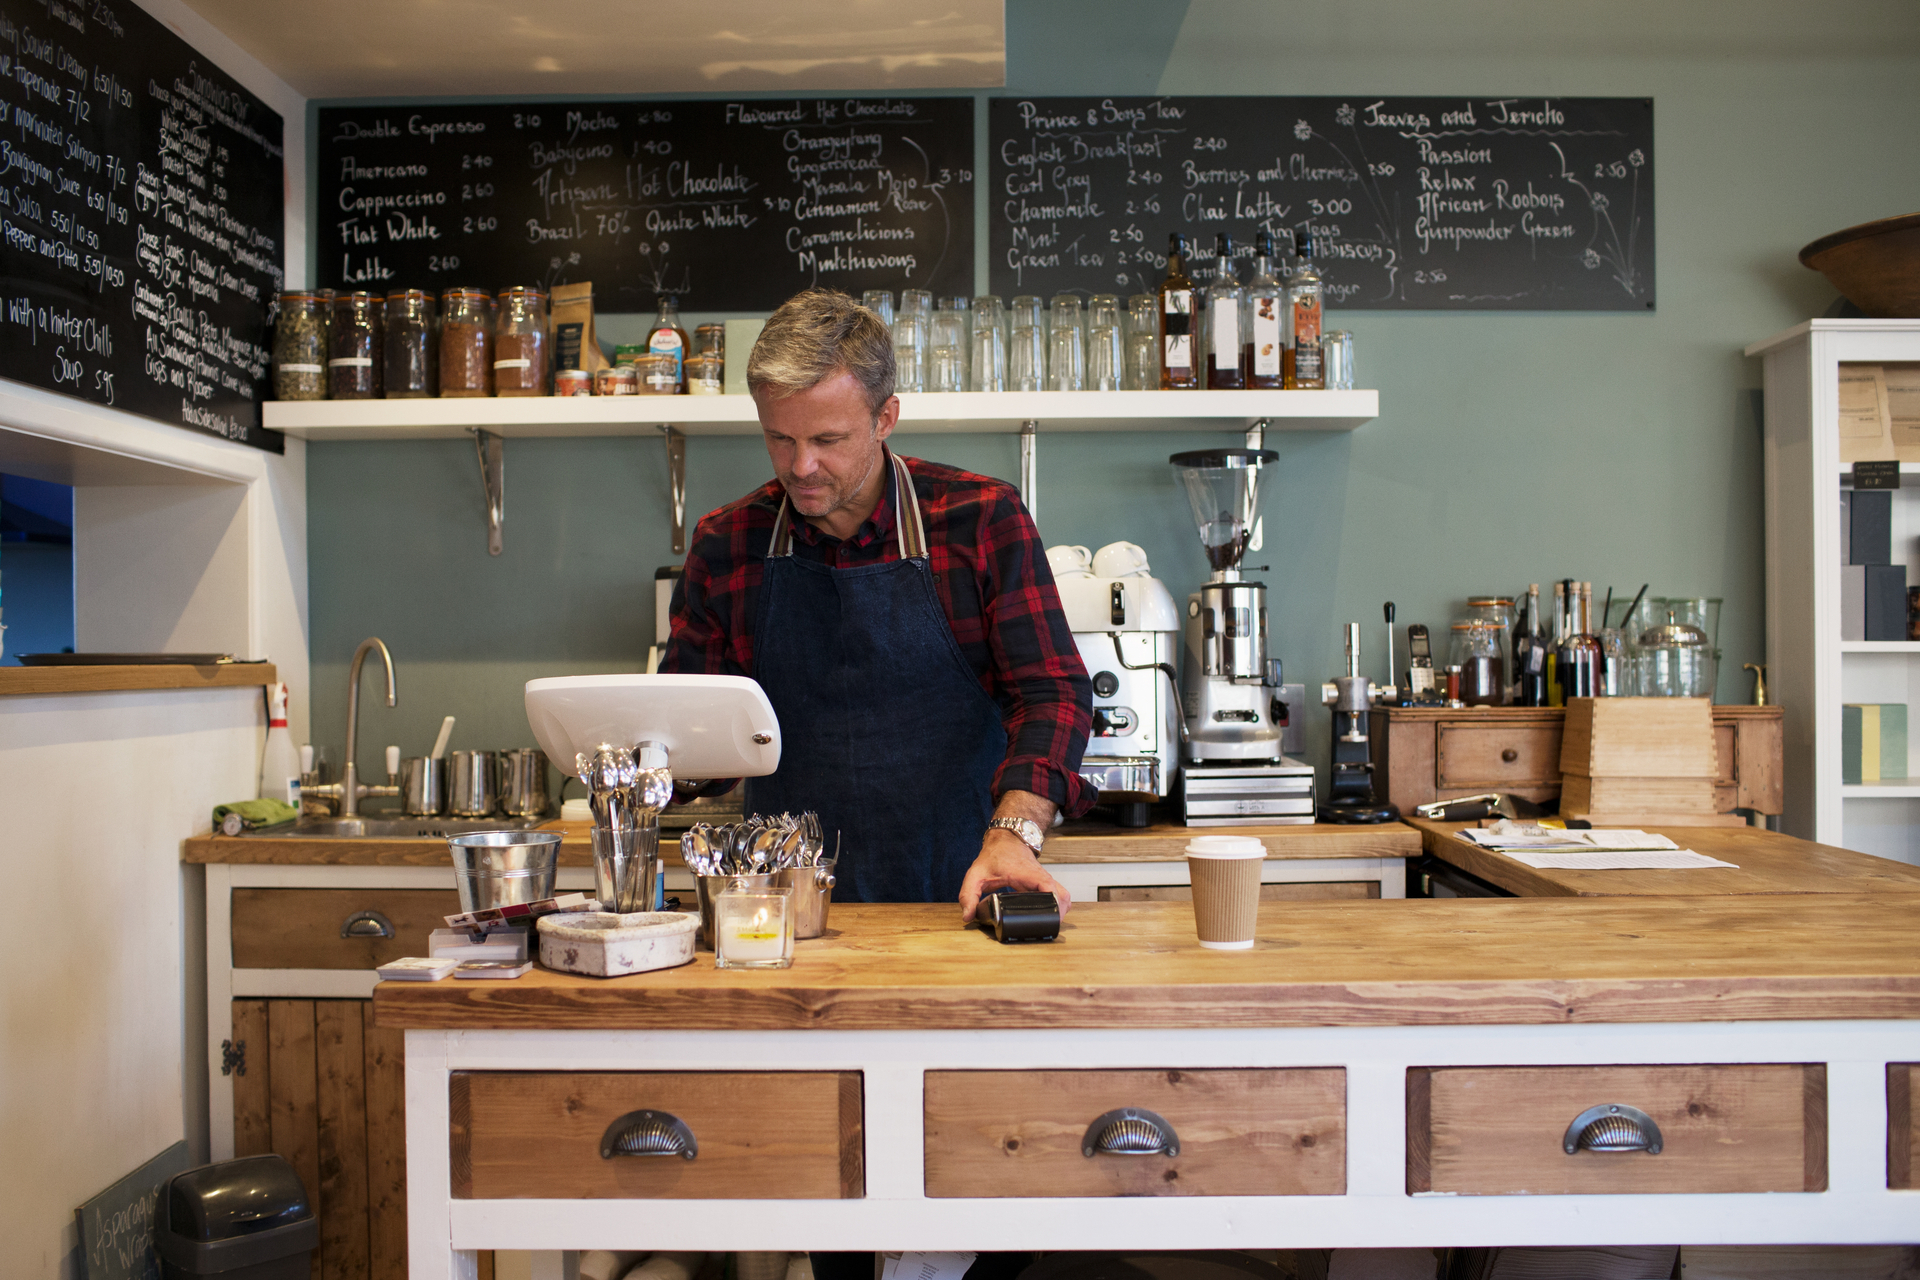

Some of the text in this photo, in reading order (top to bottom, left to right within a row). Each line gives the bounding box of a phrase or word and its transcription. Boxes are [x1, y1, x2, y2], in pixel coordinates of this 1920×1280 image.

[57, 45, 88, 90] Cream
[14, 58, 61, 106] tapenade
[66, 88, 90, 125] 7/12
[161, 107, 180, 135] White
[566, 110, 619, 145] Mocha
[726, 98, 918, 124] Flavoured Hot Chocolate
[1017, 96, 1187, 129] Prince & Sons Tea
[1363, 99, 1565, 132] Jeeves and Jericho
[159, 128, 182, 154] Brown
[333, 120, 402, 143] Double
[408, 115, 486, 144] Espresso
[63, 133, 101, 174] Salmon
[106, 154, 127, 190] 7/12
[158, 149, 186, 176] Toasted
[528, 140, 613, 176] Babycino
[787, 151, 884, 183] Gingerbread
[1001, 136, 1067, 177] English
[1068, 131, 1167, 169] Breakfast
[1416, 138, 1493, 164] Passion
[53, 167, 81, 197] Sauce
[341, 156, 428, 182] Americano
[1005, 168, 1044, 197] Earl
[1052, 165, 1092, 206] Grey
[1181, 159, 1250, 191] Berries
[1257, 157, 1286, 182] and
[1289, 152, 1359, 188] Cherries
[1416, 166, 1476, 192] Relax
[161, 174, 186, 204] Smoked
[339, 187, 447, 217] Cappuccino
[532, 160, 758, 221] Artisan Hot Chocolate
[802, 172, 871, 207] Masala
[877, 170, 917, 206] Mojo
[1416, 178, 1565, 227] African Roobois
[795, 191, 932, 220] Cinnamon Rose
[1004, 191, 1105, 224] Chamomile
[1182, 192, 1228, 223] Chai
[1234, 190, 1292, 219] Latte
[337, 217, 379, 244] Flat
[387, 211, 441, 241] White
[526, 213, 587, 243] Brazil
[596, 210, 630, 245] 70%
[703, 205, 758, 228] White
[1012, 222, 1060, 258] Mint
[1294, 216, 1341, 238] Teas
[1415, 215, 1516, 254] Gunpowder
[1521, 210, 1576, 260] Green
[40, 238, 55, 258] and
[55, 241, 79, 272] Pitta
[1007, 247, 1060, 287] Green
[1065, 233, 1105, 267] Tea
[1312, 237, 1383, 262] Hibiscus
[343, 253, 396, 283] Latte
[39, 306, 48, 333] a
[50, 306, 71, 343] hint
[84, 317, 113, 358] Chilli
[52, 345, 84, 388] Soup
[171, 369, 185, 388] and
